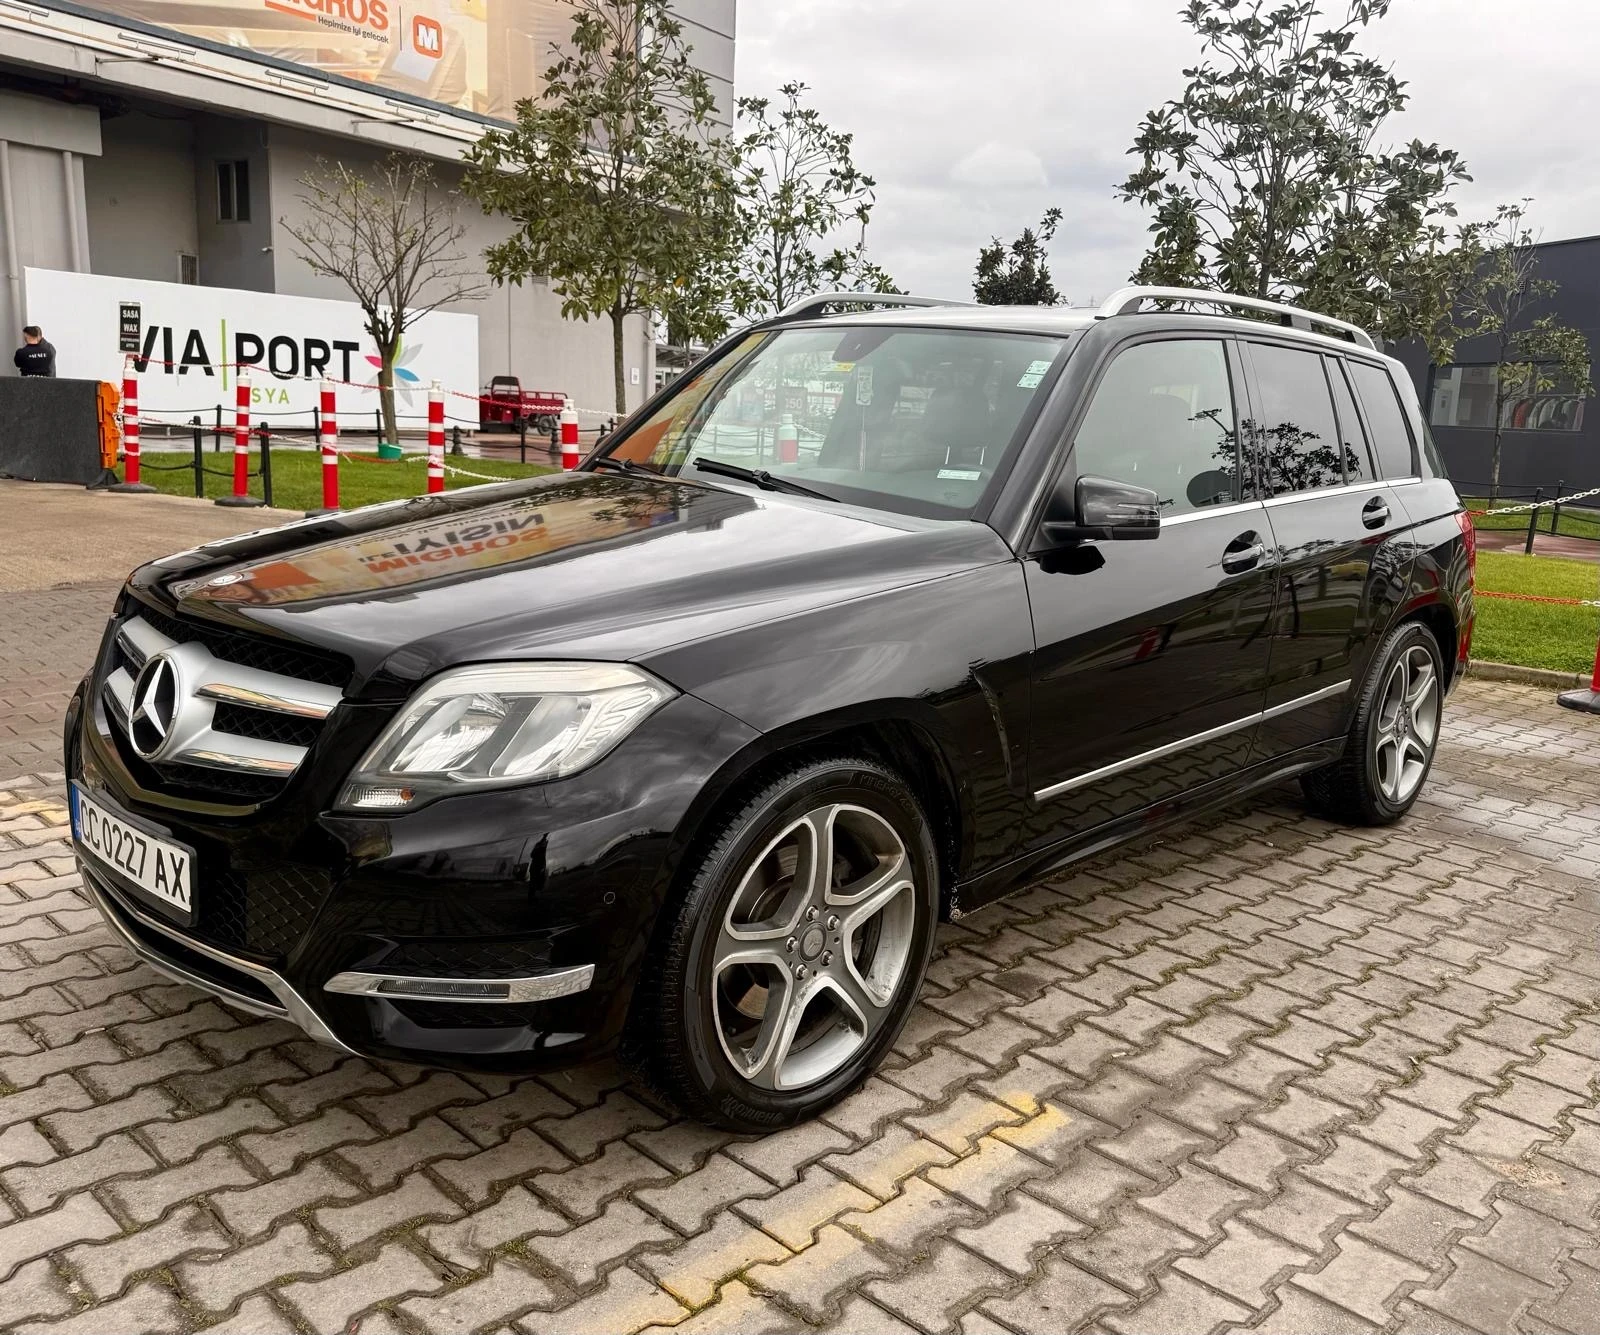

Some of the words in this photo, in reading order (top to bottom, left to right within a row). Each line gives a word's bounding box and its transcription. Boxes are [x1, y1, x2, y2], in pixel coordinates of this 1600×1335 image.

[318, 15, 352, 33] Hepimize
[362, 30, 389, 44] gelecek
[122, 309, 139, 319] SASA
[123, 323, 138, 333] WAX
[235, 332, 360, 381] PORT
[251, 387, 290, 404] SYA
[80, 799, 100, 850] CC
[102, 817, 147, 879] 0227
[155, 848, 186, 902] AX
